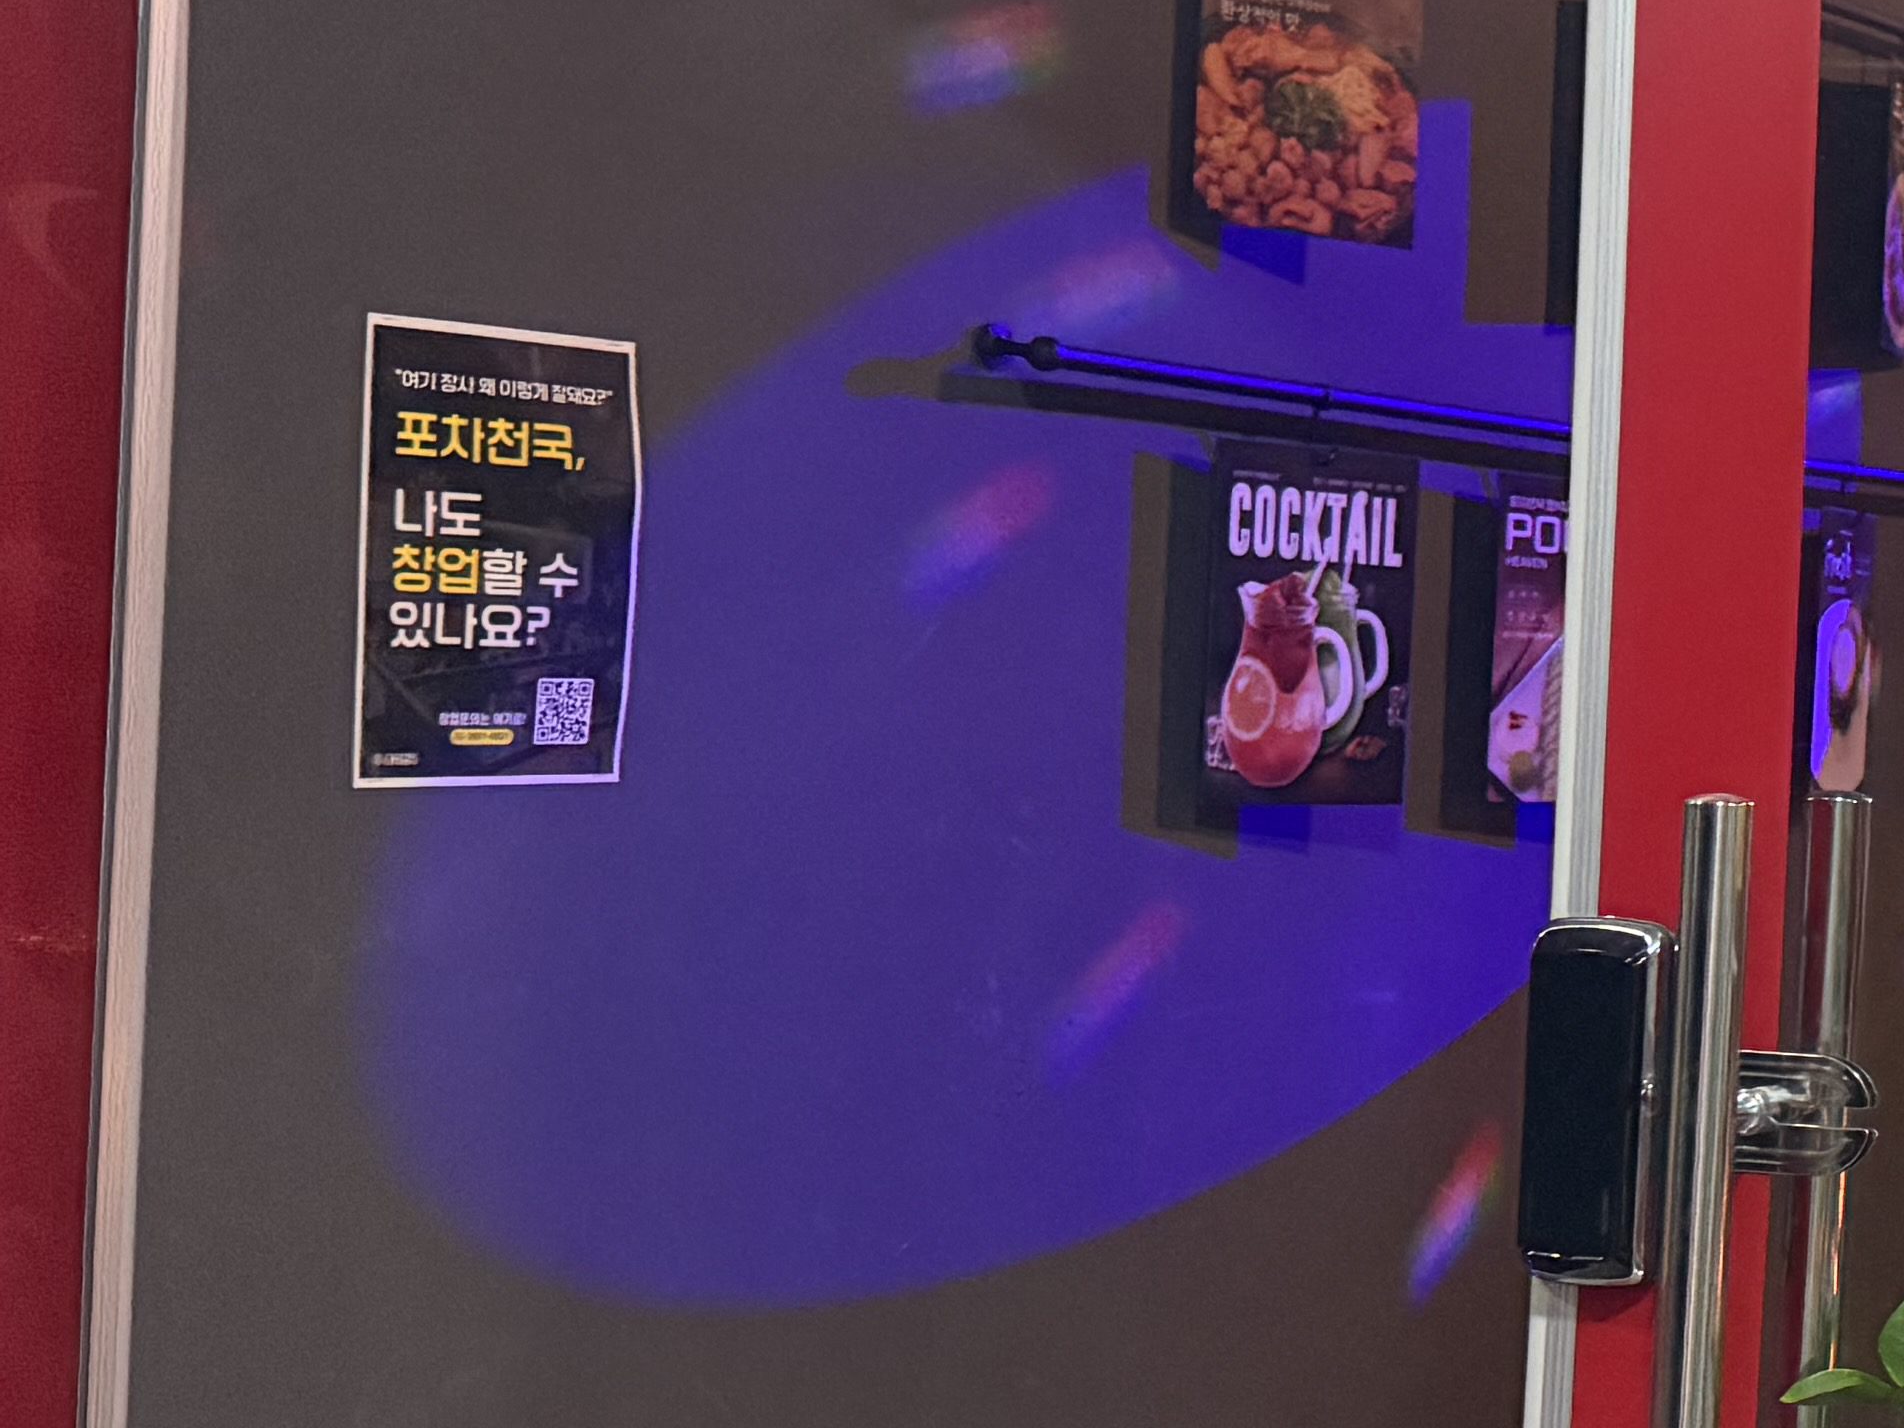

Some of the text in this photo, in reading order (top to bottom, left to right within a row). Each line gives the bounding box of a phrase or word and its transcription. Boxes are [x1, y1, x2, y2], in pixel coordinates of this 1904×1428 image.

[440, 373, 474, 394] 장사
[479, 377, 496, 396] 왜
[395, 411, 586, 471] 포차천국,
[394, 488, 483, 538] 나도
[1229, 482, 1403, 568] COCKTAIL
[1505, 513, 1569, 554] PO
[391, 544, 579, 598] 창업할 수
[389, 601, 551, 649] 있나요?
